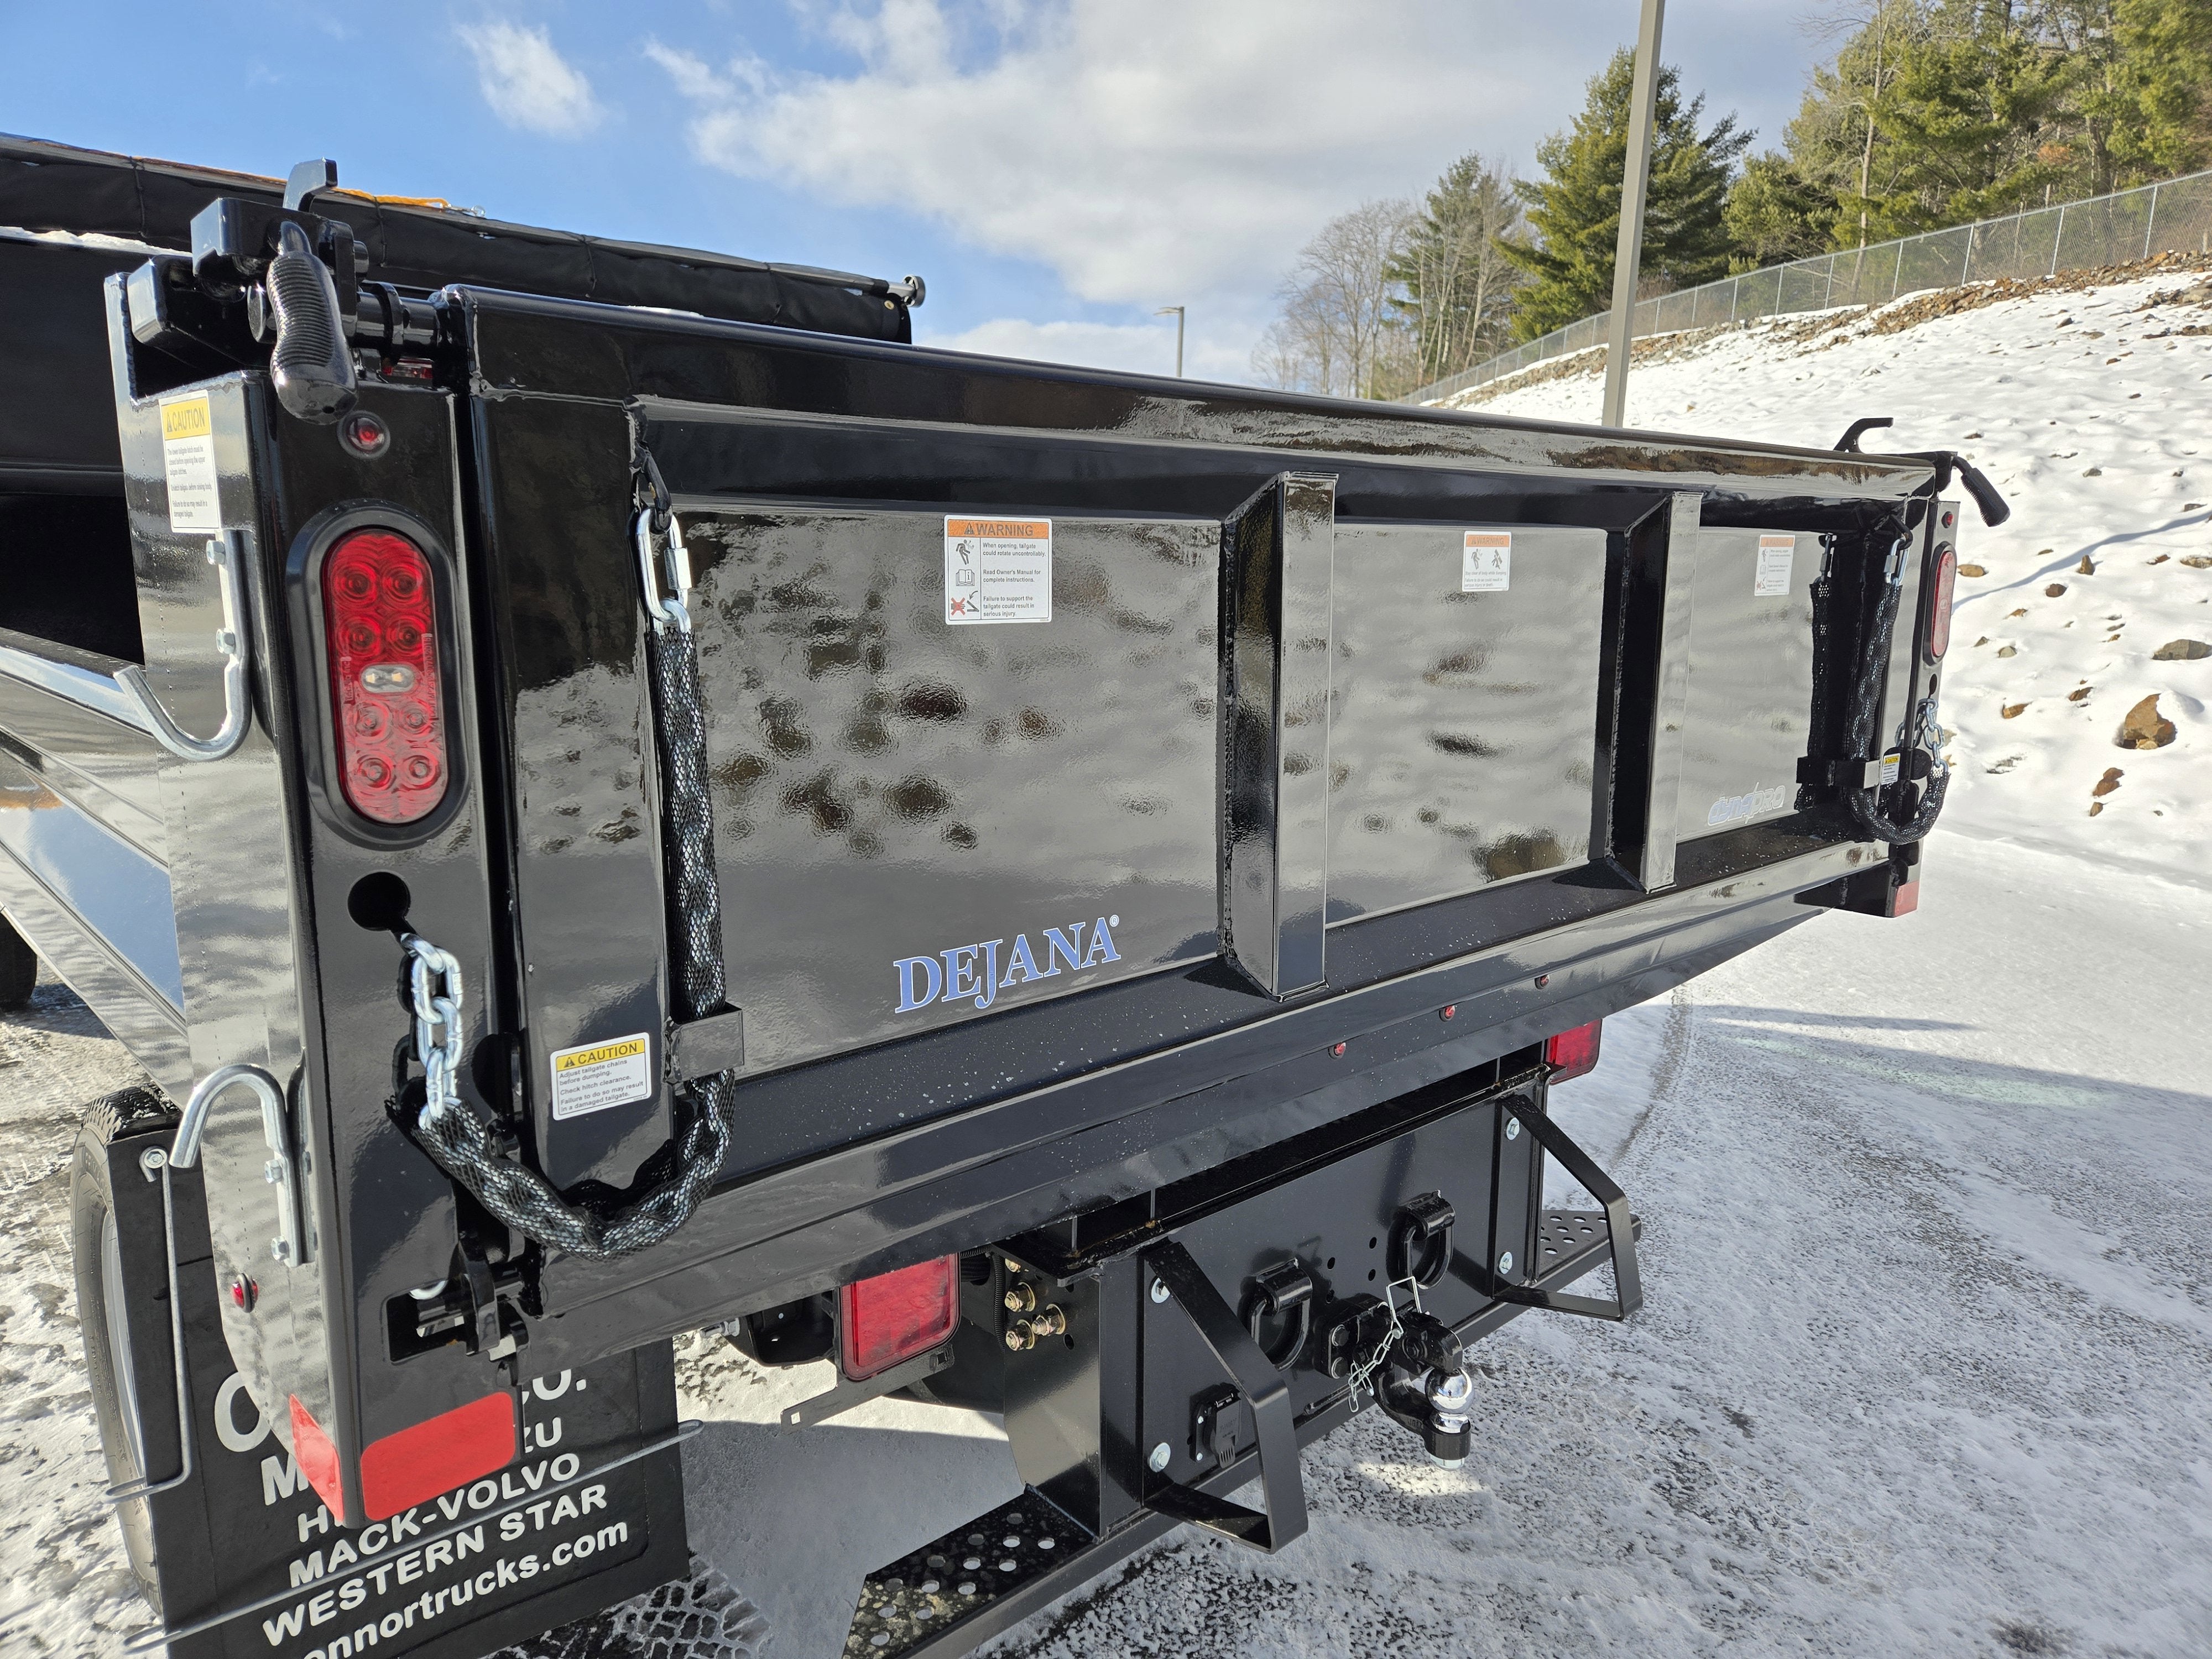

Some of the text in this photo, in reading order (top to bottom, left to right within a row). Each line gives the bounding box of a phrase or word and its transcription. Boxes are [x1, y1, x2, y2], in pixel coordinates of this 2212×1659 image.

[172, 407, 205, 431] CAUTION
[976, 523, 1033, 536] WARNING
[578, 1042, 637, 1065] CAUTION
[560, 1060, 627, 1079] Adjust tailgate chains
[560, 1071, 612, 1086] before dumping.
[560, 1086, 581, 1095] Check
[599, 1075, 632, 1086] clearance.
[561, 1096, 582, 1105] Failure
[626, 1081, 643, 1090] result
[575, 1098, 604, 1109] damaged
[605, 1092, 629, 1102] tailgate.
[289, 1453, 580, 1588] MACK-VOLVO
[262, 1484, 607, 1646] WESTERN STAR
